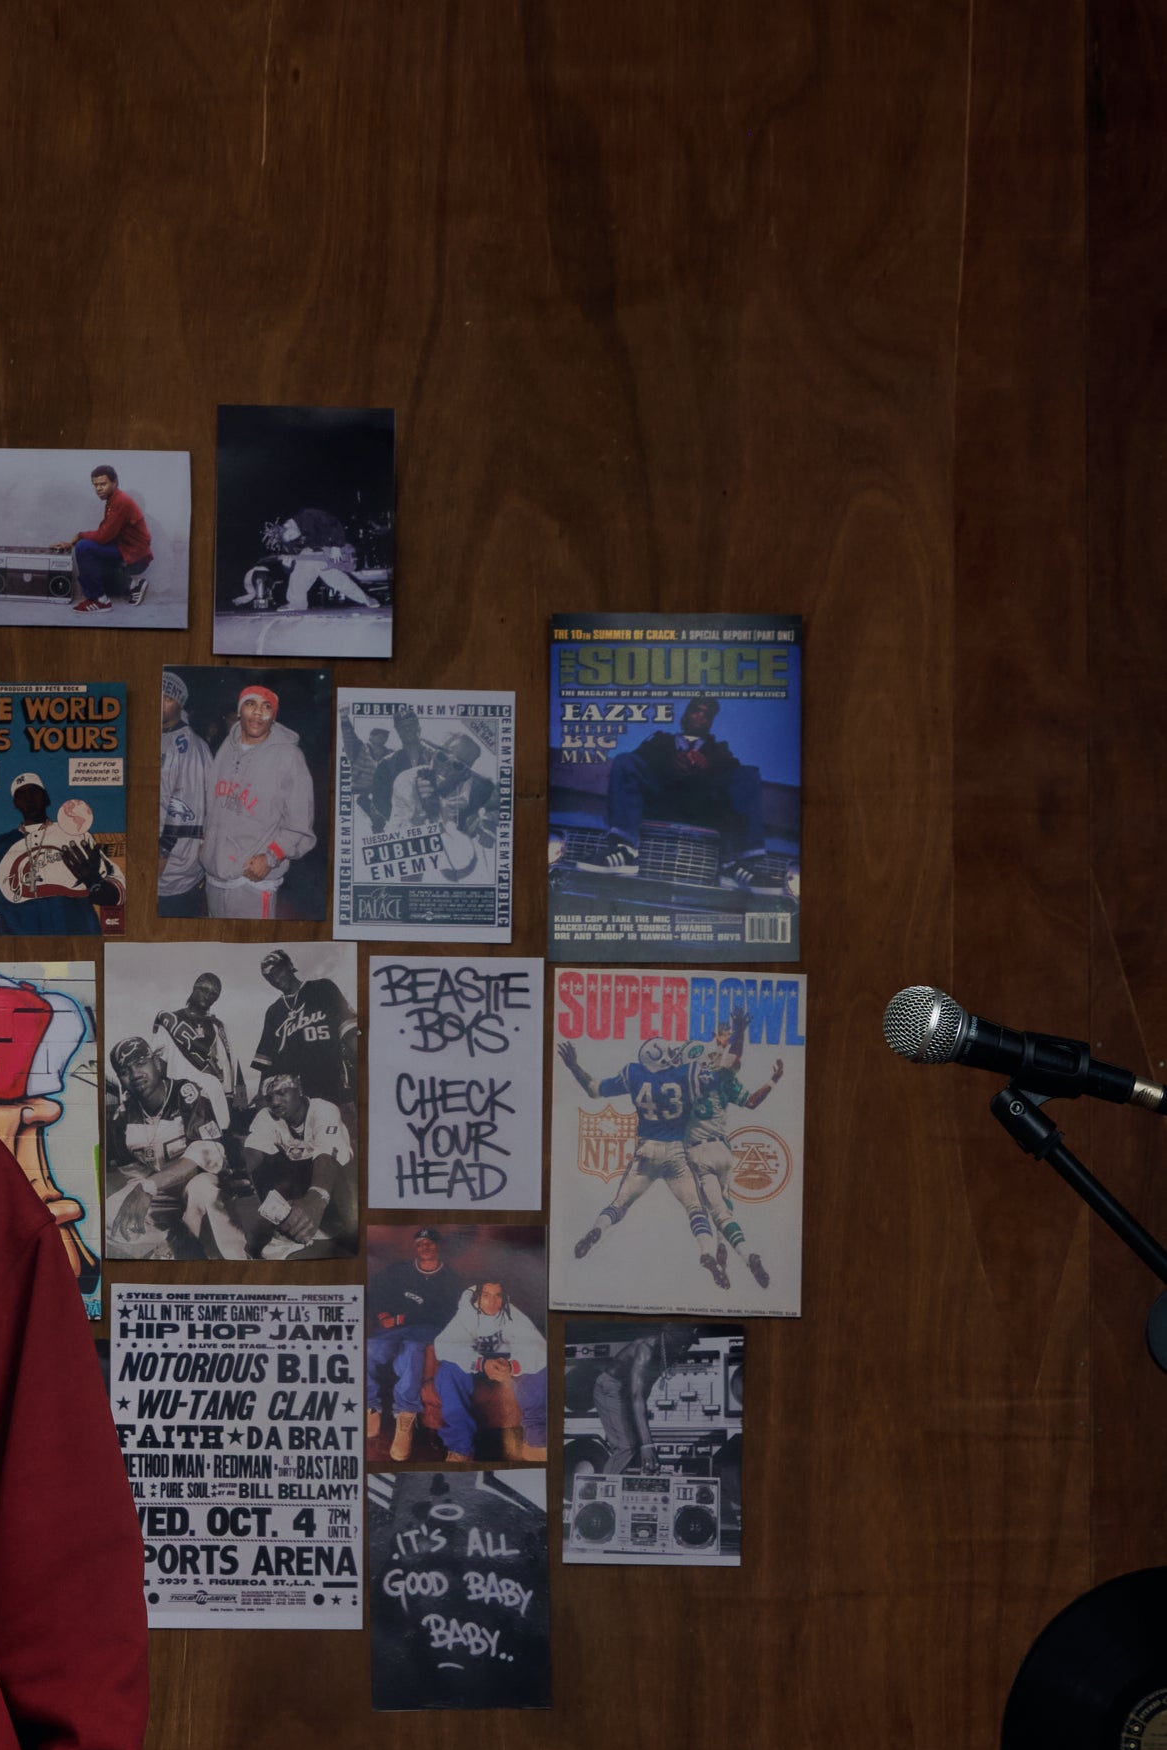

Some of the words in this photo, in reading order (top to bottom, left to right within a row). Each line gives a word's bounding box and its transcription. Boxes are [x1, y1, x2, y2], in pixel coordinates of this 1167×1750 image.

[577, 646, 789, 687] SOURCE
[23, 697, 121, 723] WORLD
[353, 704, 405, 715] PUBLIC
[408, 705, 456, 716] ENEMY
[458, 705, 511, 717] PUBLIC
[561, 703, 649, 722] EAZY
[653, 703, 672, 722] E
[25, 726, 118, 752] YOURS
[501, 718, 511, 767] ENEMY
[561, 750, 607, 764] MAN
[340, 757, 351, 813] PUBLIC
[500, 768, 511, 820] PUBLIC
[341, 817, 351, 864] ENEMY
[427, 825, 438, 834] 27
[364, 836, 442, 865] PUBLIC
[499, 822, 509, 870] ENEMY
[370, 855, 439, 881] ENEMY
[340, 866, 351, 921] PUBLIC
[357, 898, 402, 919] PALACE
[498, 870, 510, 926] PUBLIC
[373, 964, 531, 1013] BEASTIE
[557, 971, 690, 1043] SUPER
[689, 976, 805, 1046] BOWL
[304, 1025, 331, 1042] 05
[405, 1007, 510, 1057] BOYS
[396, 1072, 516, 1121] CHECK
[635, 1082, 684, 1121] 43
[407, 1114, 511, 1162] YOUR
[584, 1136, 631, 1172] NFL
[396, 1151, 508, 1202] HEAD
[126, 1292, 164, 1300] SYKES
[160, 1304, 172, 1321] IN
[175, 1305, 194, 1321] THE
[198, 1305, 229, 1322] SAME
[120, 1322, 180, 1339] HIP
[187, 1323, 261, 1340] HOP
[269, 1324, 356, 1341] JAM!
[118, 1352, 269, 1383] NOTORIOUS
[277, 1354, 354, 1384] B.I.G.
[137, 1389, 257, 1421] WU-TANG
[267, 1391, 340, 1421] CLAN
[115, 1424, 224, 1449] FAITH
[247, 1426, 284, 1450] DA
[288, 1427, 358, 1450] BRAT
[172, 1454, 205, 1479] MAN
[213, 1455, 273, 1479] REDMAN
[296, 1455, 359, 1480] BASTARD
[160, 1482, 184, 1498] PURE
[187, 1482, 211, 1498] SOUL
[238, 1483, 274, 1499] BILL
[278, 1484, 359, 1500] BELLAMY!
[207, 1506, 278, 1538] OCT.
[293, 1508, 316, 1538] 4
[327, 1509, 350, 1525] 7PM
[466, 1526, 520, 1558] ALL
[144, 1545, 239, 1575] PORTS
[251, 1545, 357, 1576] ARENA
[157, 1578, 188, 1586] 3939
[192, 1578, 204, 1586] S.
[209, 1578, 267, 1586] FIGUEROA
[383, 1568, 449, 1613] GOOD
[462, 1571, 533, 1618] BABY
